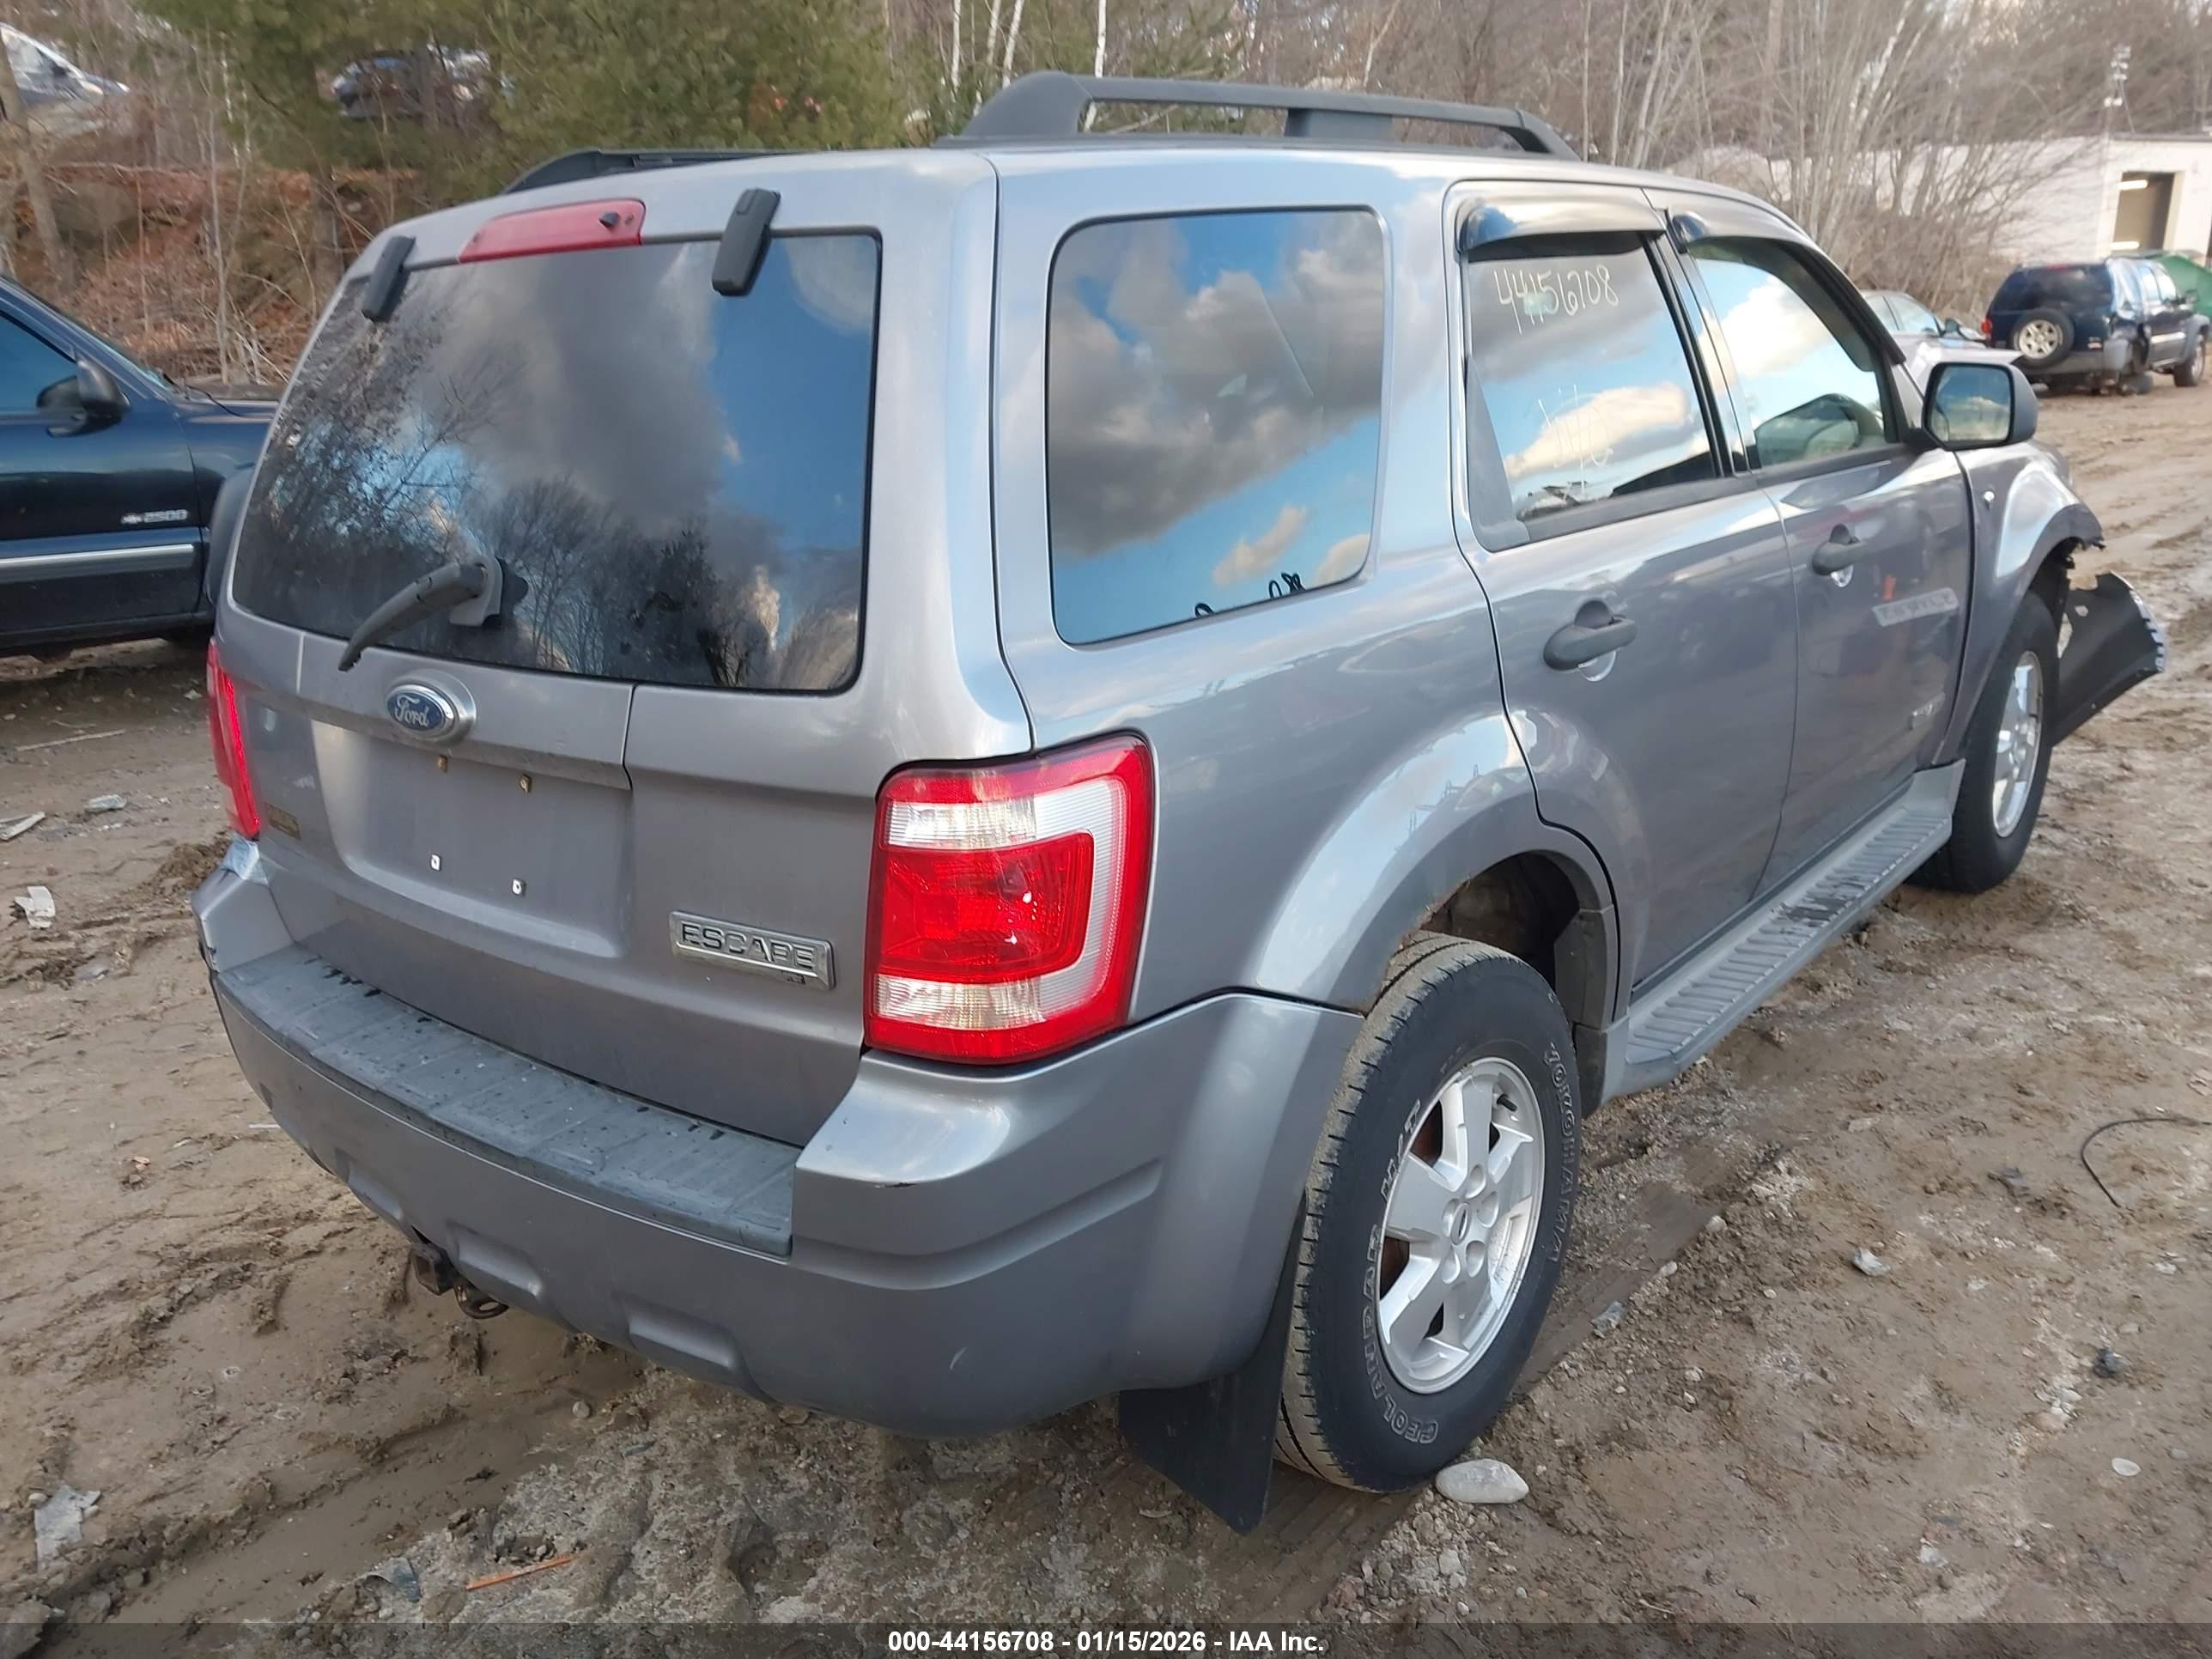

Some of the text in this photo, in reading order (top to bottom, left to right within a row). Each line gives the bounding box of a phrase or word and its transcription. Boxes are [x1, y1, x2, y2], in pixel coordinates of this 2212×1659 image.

[1493, 263, 1620, 336] 44156708
[395, 694, 430, 727] Ford
[681, 921, 815, 970] ESCAPE
[1544, 1042, 1576, 1263] YOKOHAMA
